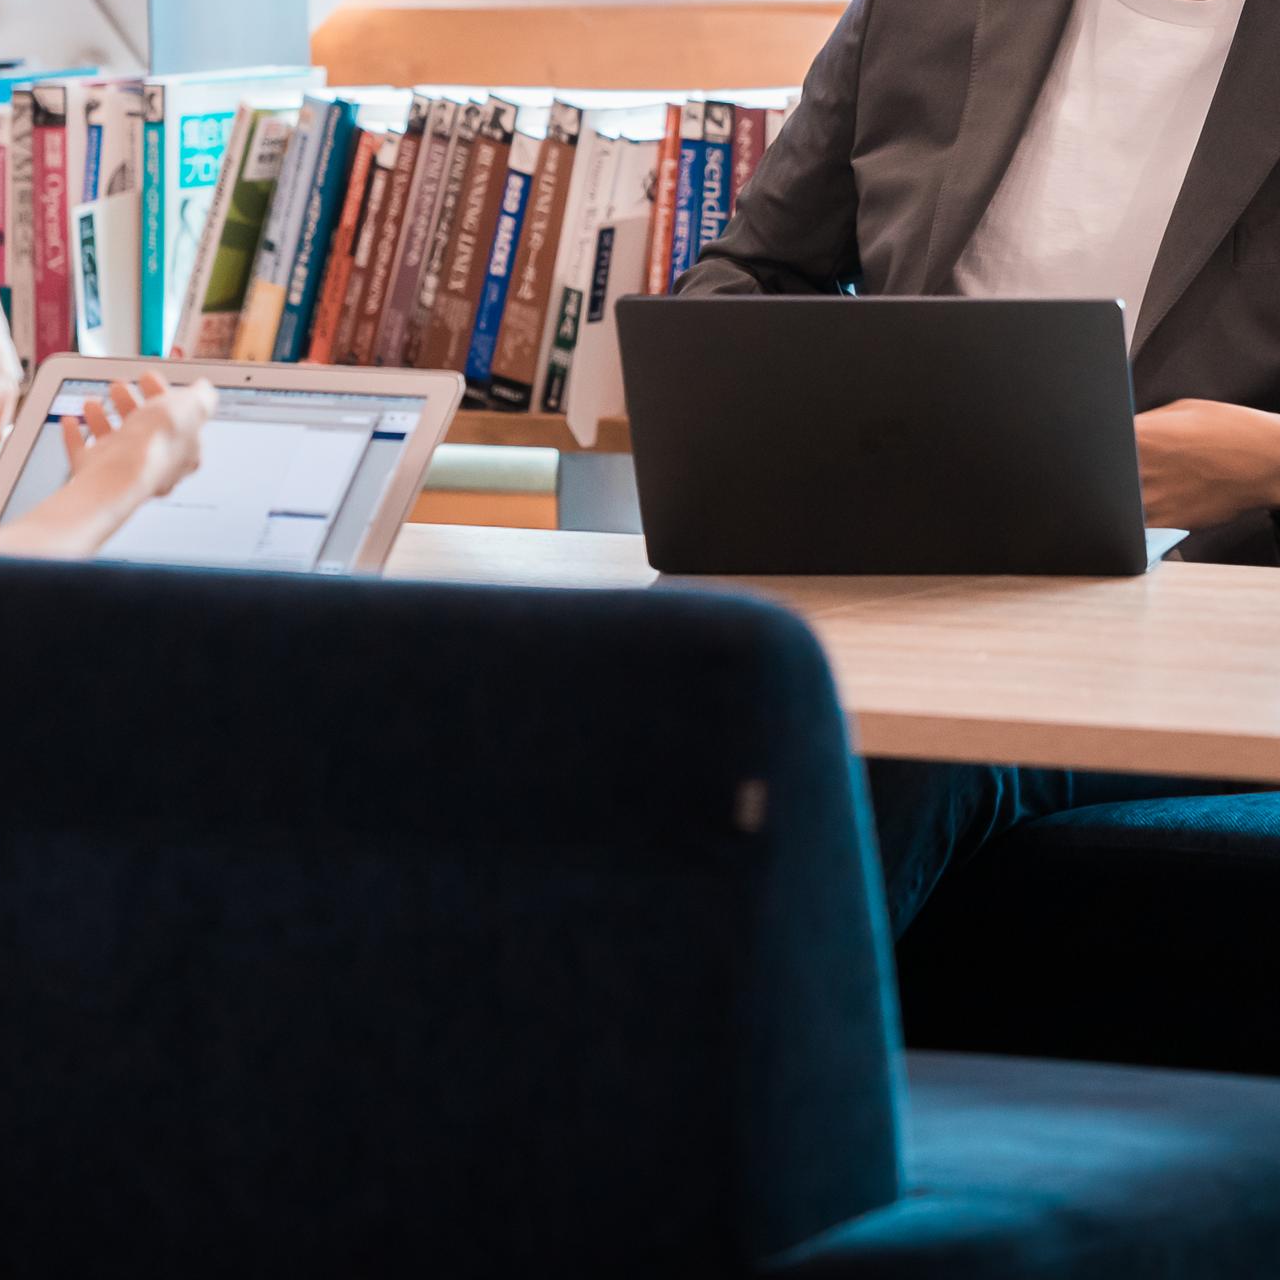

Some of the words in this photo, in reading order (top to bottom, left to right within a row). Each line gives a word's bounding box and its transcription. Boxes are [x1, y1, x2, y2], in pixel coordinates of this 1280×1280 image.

[40, 173, 66, 270] OpenCV
[461, 143, 497, 232] RUNNING
[700, 147, 728, 246] sendm
